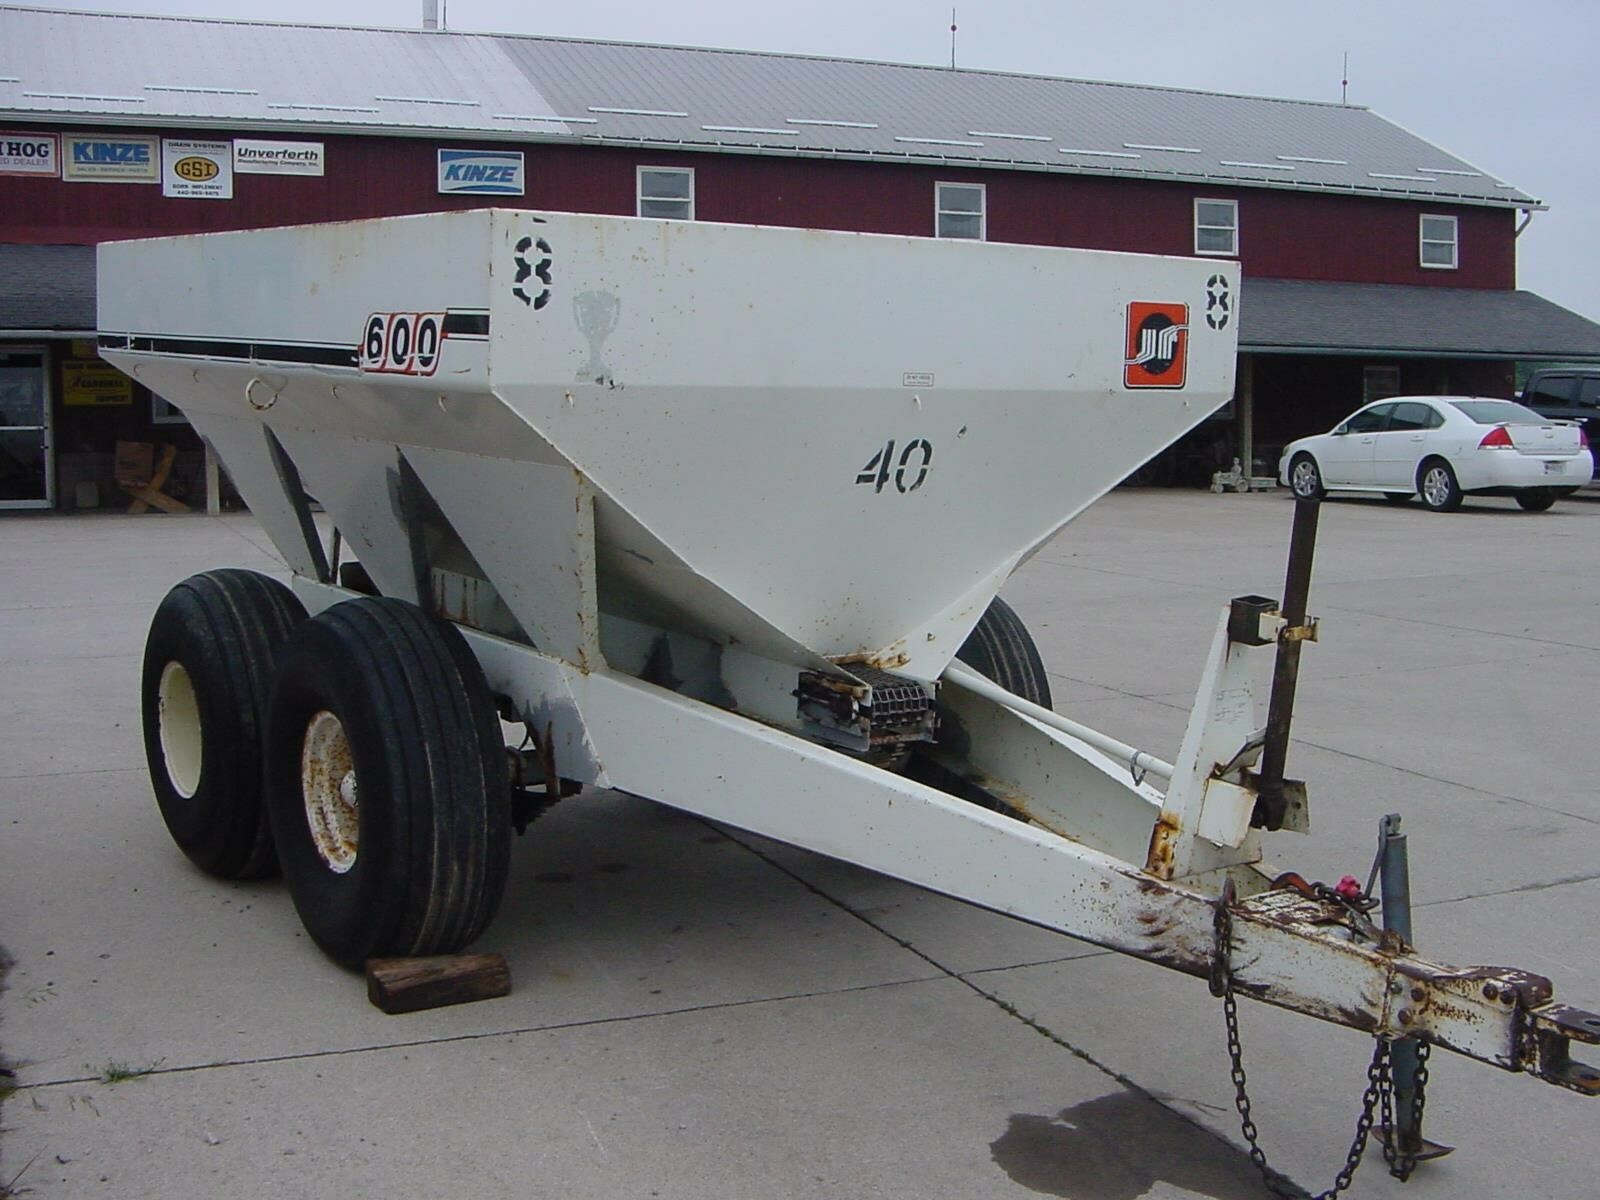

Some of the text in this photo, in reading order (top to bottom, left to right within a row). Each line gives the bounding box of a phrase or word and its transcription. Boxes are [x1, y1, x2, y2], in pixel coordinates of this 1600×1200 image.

[6, 141, 49, 158] HOG
[72, 142, 150, 162] KINZE
[237, 147, 319, 161] Unverferth
[13, 157, 49, 166] DEALER
[181, 161, 213, 178] GSI
[444, 164, 519, 182] KINZE
[367, 317, 437, 368] 600
[855, 439, 933, 494] 40
